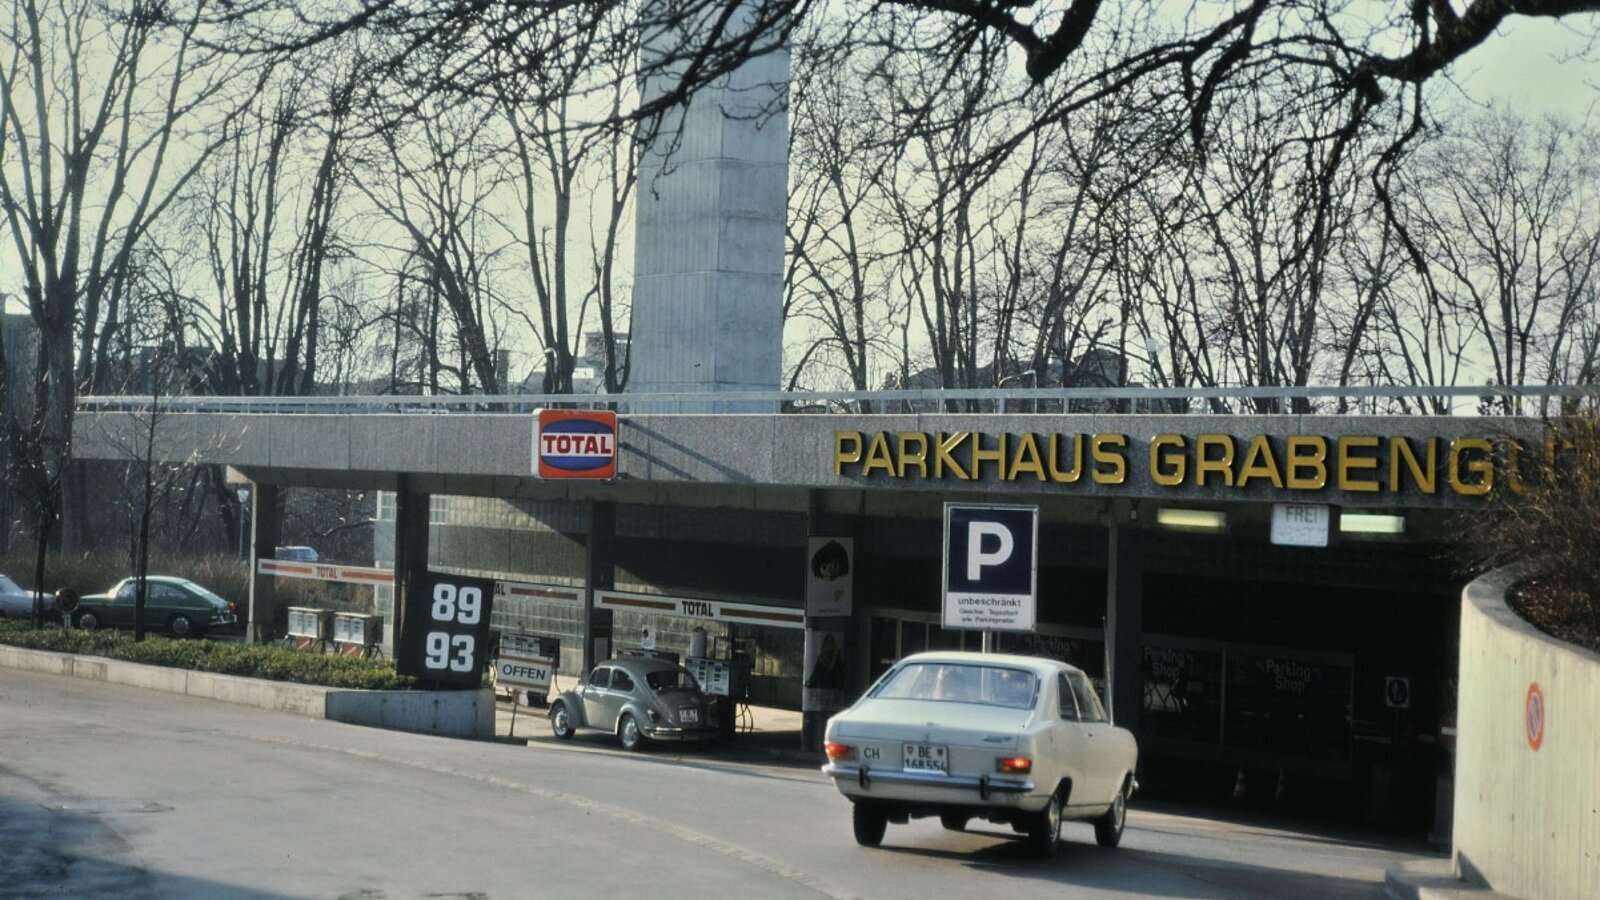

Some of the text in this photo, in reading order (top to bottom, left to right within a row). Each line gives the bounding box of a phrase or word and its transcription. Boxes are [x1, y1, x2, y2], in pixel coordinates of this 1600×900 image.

[543, 434, 612, 455] TOTAL
[834, 430, 1598, 496] PARKHAUS GRABENGU
[1286, 505, 1318, 523] FREI
[967, 521, 1015, 581] P
[316, 565, 338, 580] TOTAL
[431, 583, 482, 625] 89
[681, 600, 714, 617] TOTAL
[957, 596, 1022, 608] unbeschränkt
[425, 631, 475, 673] 93
[1143, 646, 1186, 669] Parking
[502, 664, 546, 681] OFFEN
[1151, 660, 1181, 683] Shop
[1265, 658, 1311, 682] Parking
[1273, 671, 1305, 695] Shop
[863, 746, 881, 759] CH
[917, 746, 932, 759] BE
